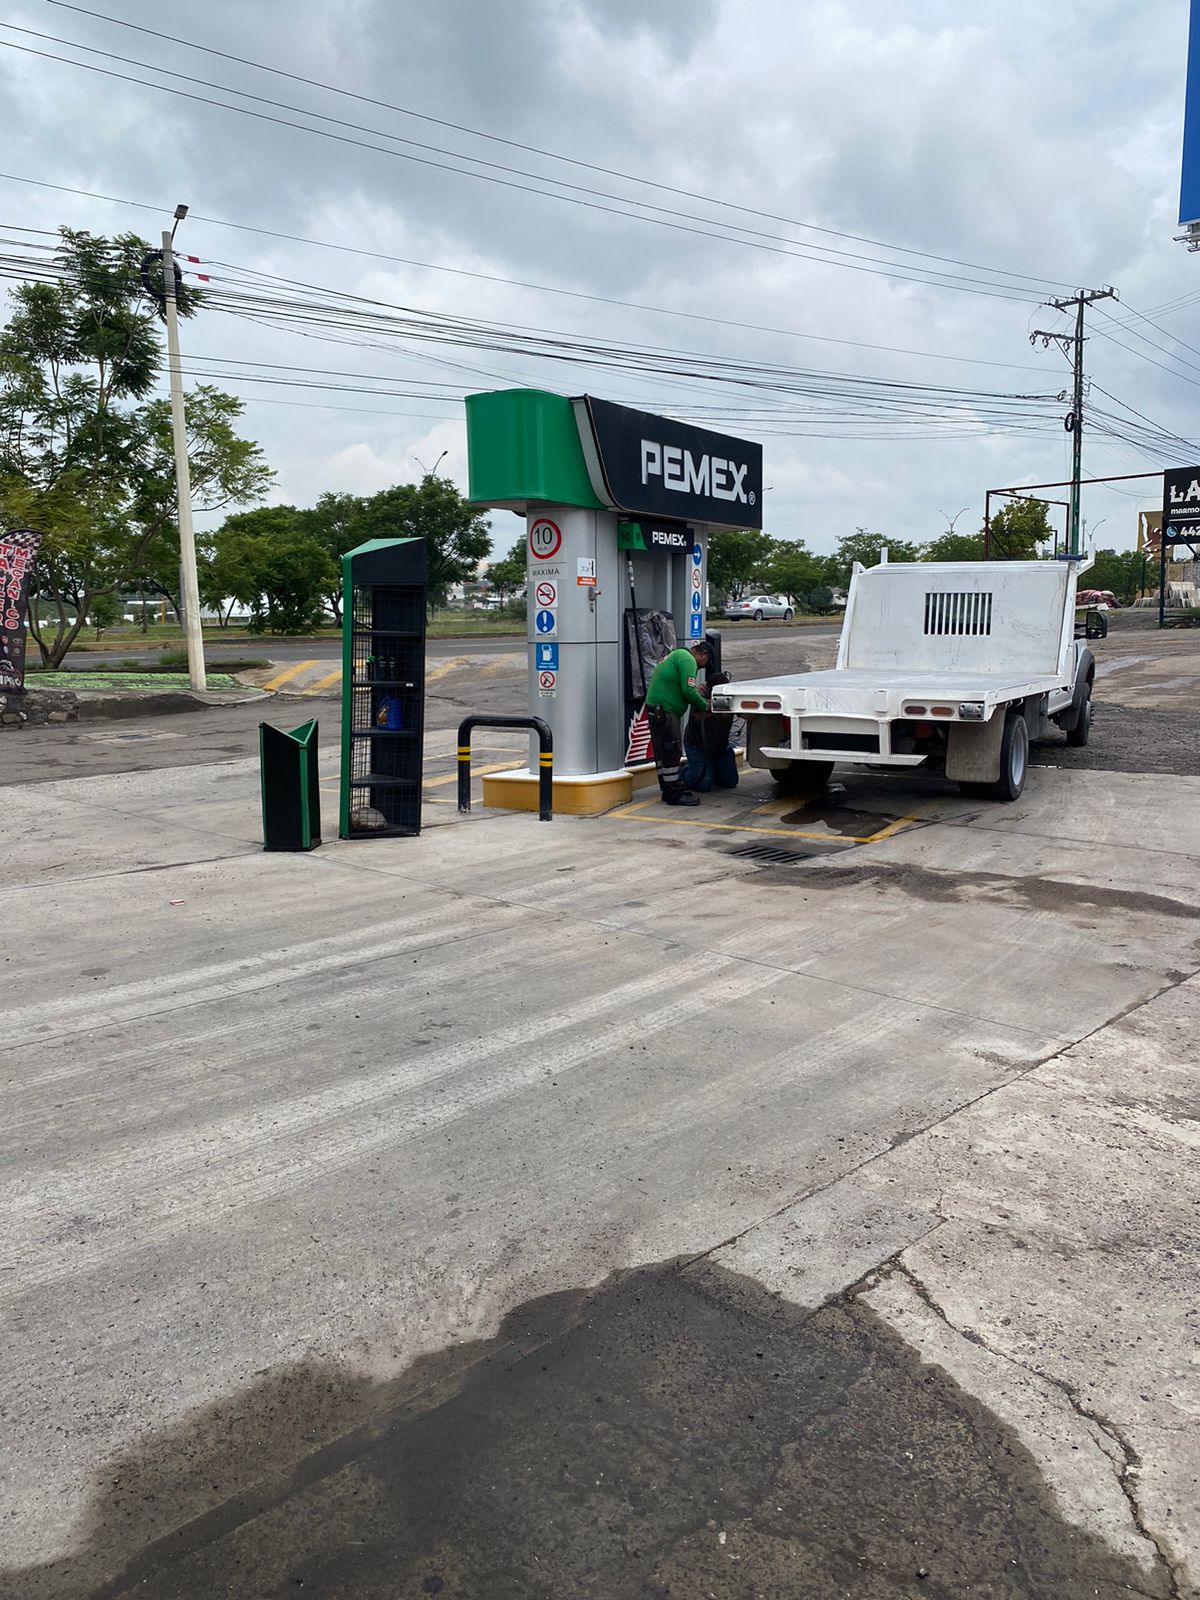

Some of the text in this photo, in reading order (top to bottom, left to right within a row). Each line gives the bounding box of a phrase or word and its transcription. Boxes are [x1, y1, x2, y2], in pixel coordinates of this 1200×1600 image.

[641, 439, 748, 504] PEMEX
[535, 527, 553, 545] 10
[652, 531, 684, 547] PEMEX
[5, 546, 31, 629] MECANICO
